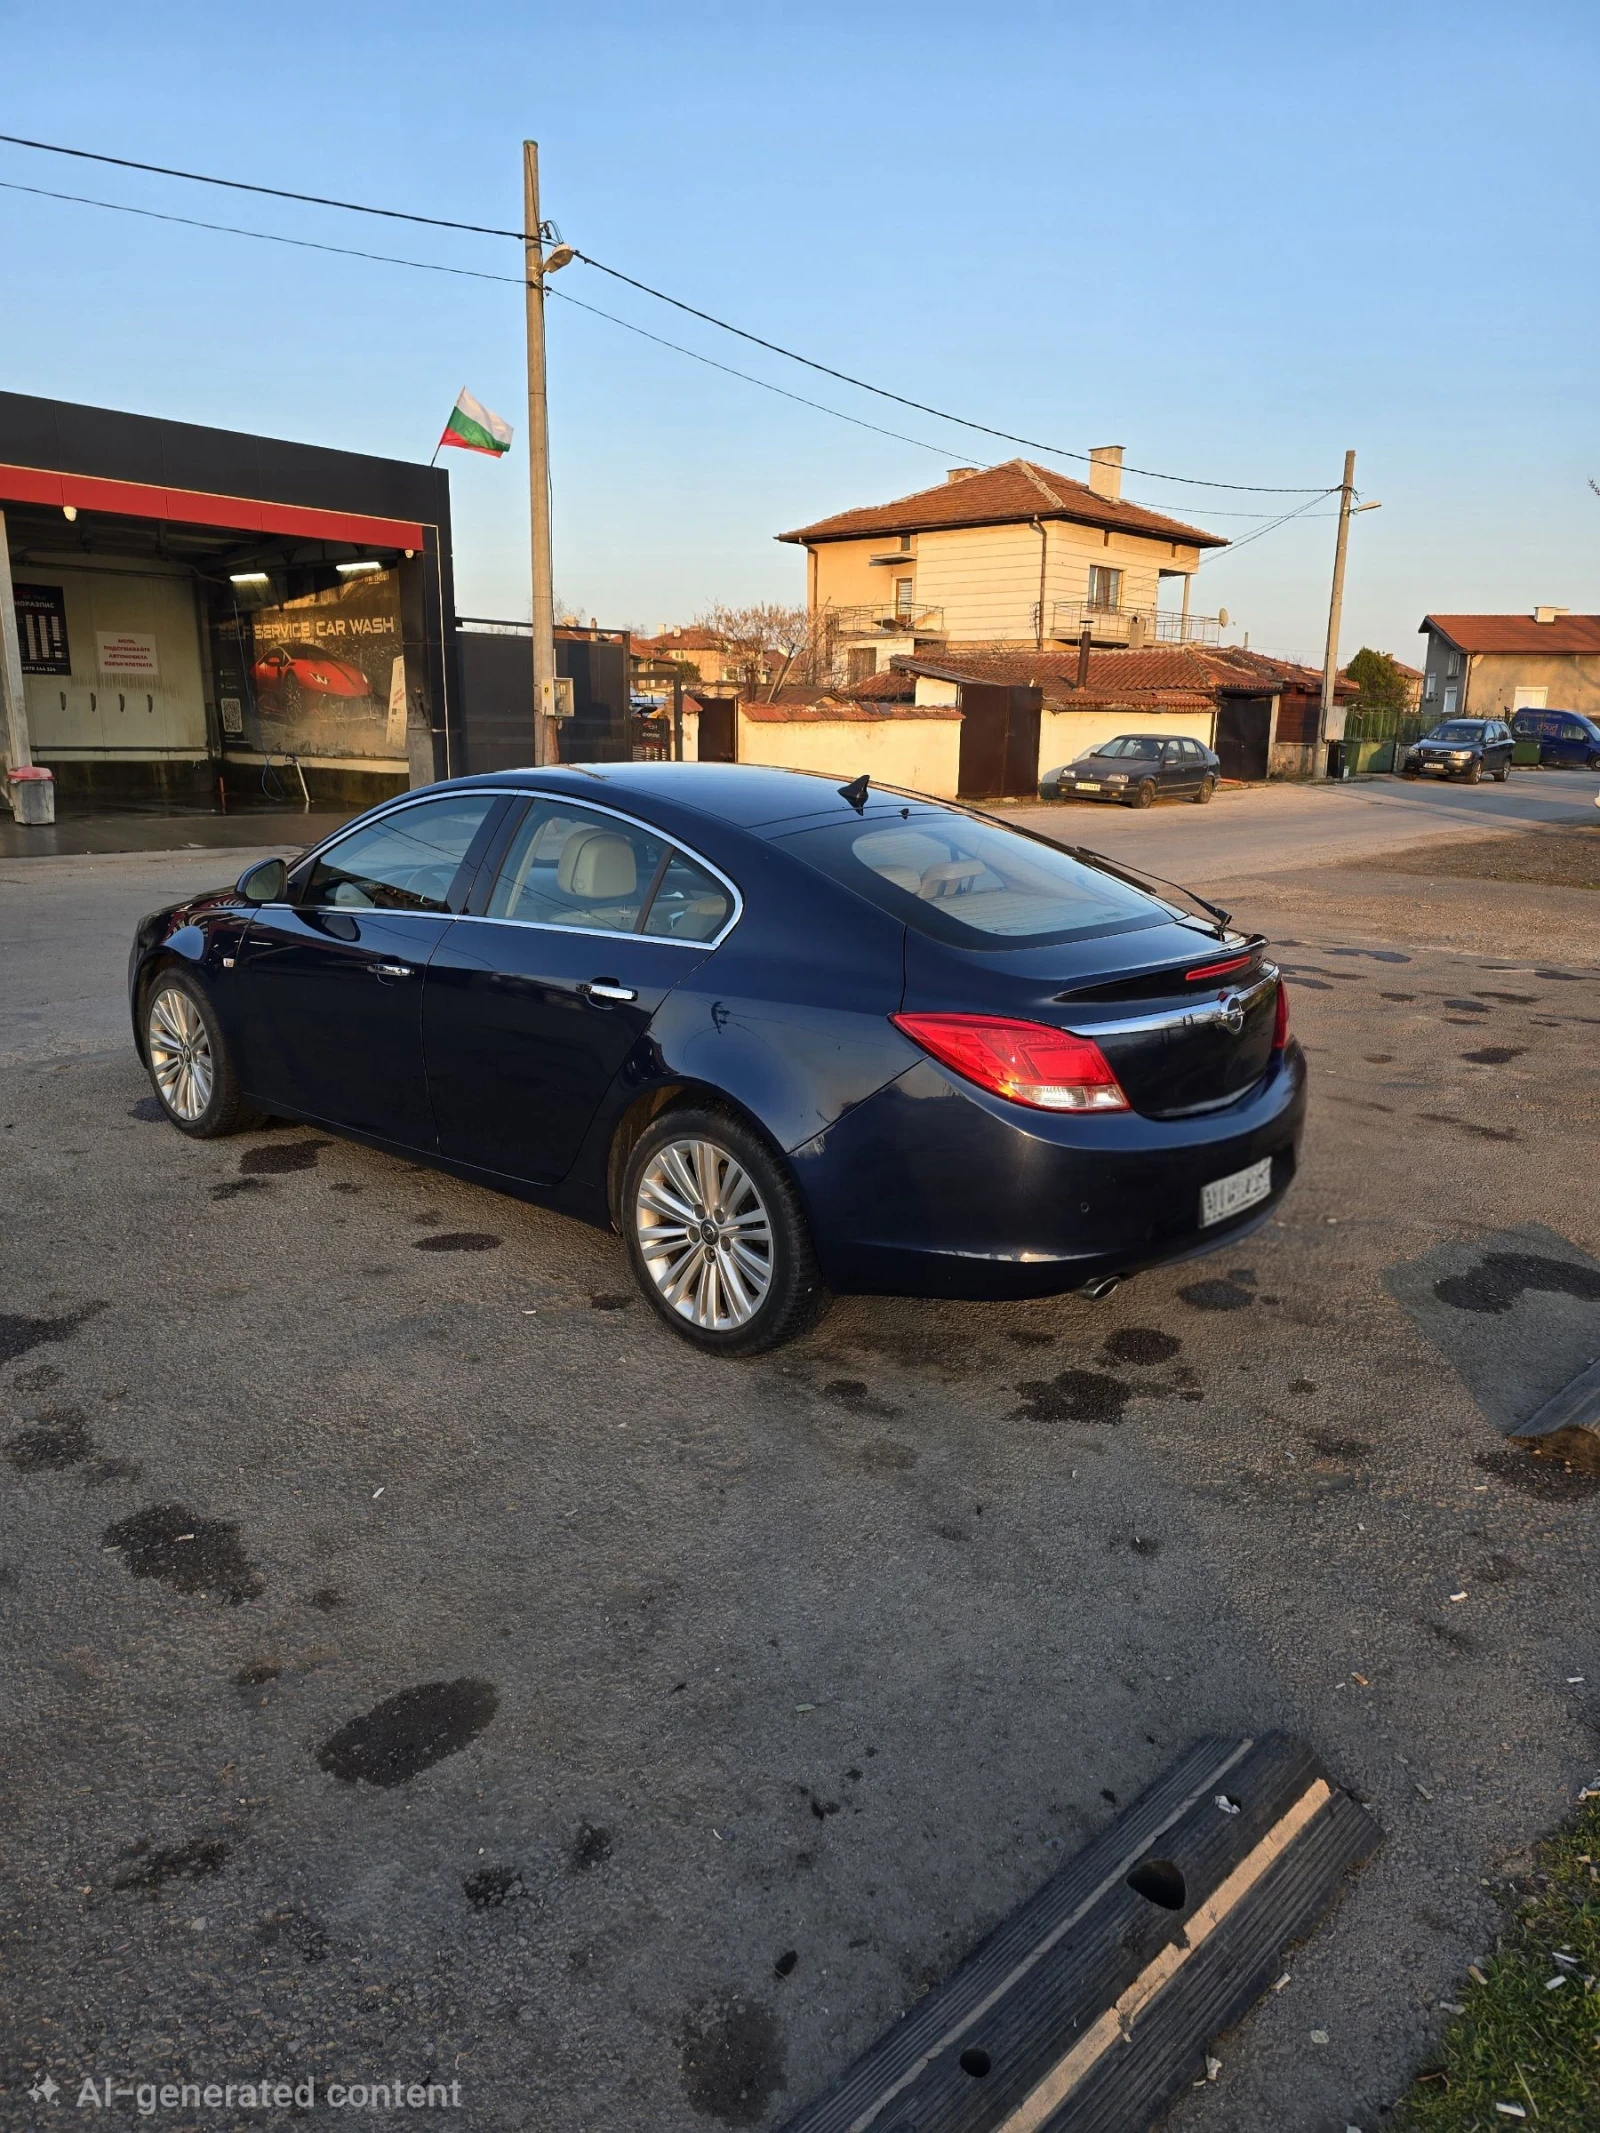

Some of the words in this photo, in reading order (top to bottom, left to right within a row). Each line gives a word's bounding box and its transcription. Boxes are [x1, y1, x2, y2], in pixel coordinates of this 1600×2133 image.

[13, 600, 56, 609] НОРАЗПИС
[254, 621, 311, 640] SERVICE
[316, 620, 346, 637] CAR
[349, 616, 395, 635] WASH
